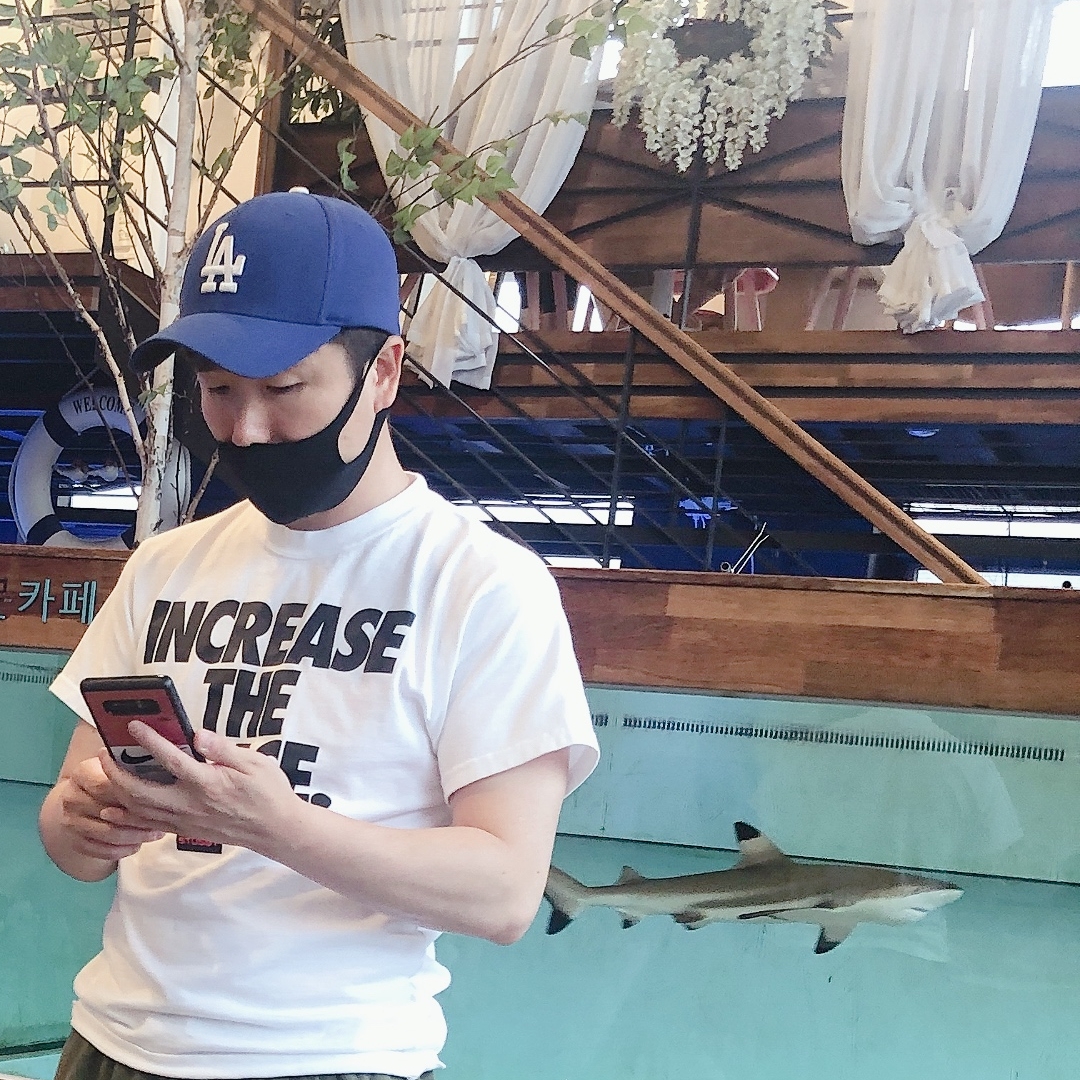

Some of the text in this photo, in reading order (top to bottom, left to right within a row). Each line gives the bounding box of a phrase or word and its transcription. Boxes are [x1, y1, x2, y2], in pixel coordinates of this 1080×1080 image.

[201, 222, 247, 293] LA
[73, 395, 132, 415] WELCOM
[143, 599, 416, 674] INCREASE
[202, 668, 301, 738] THE
